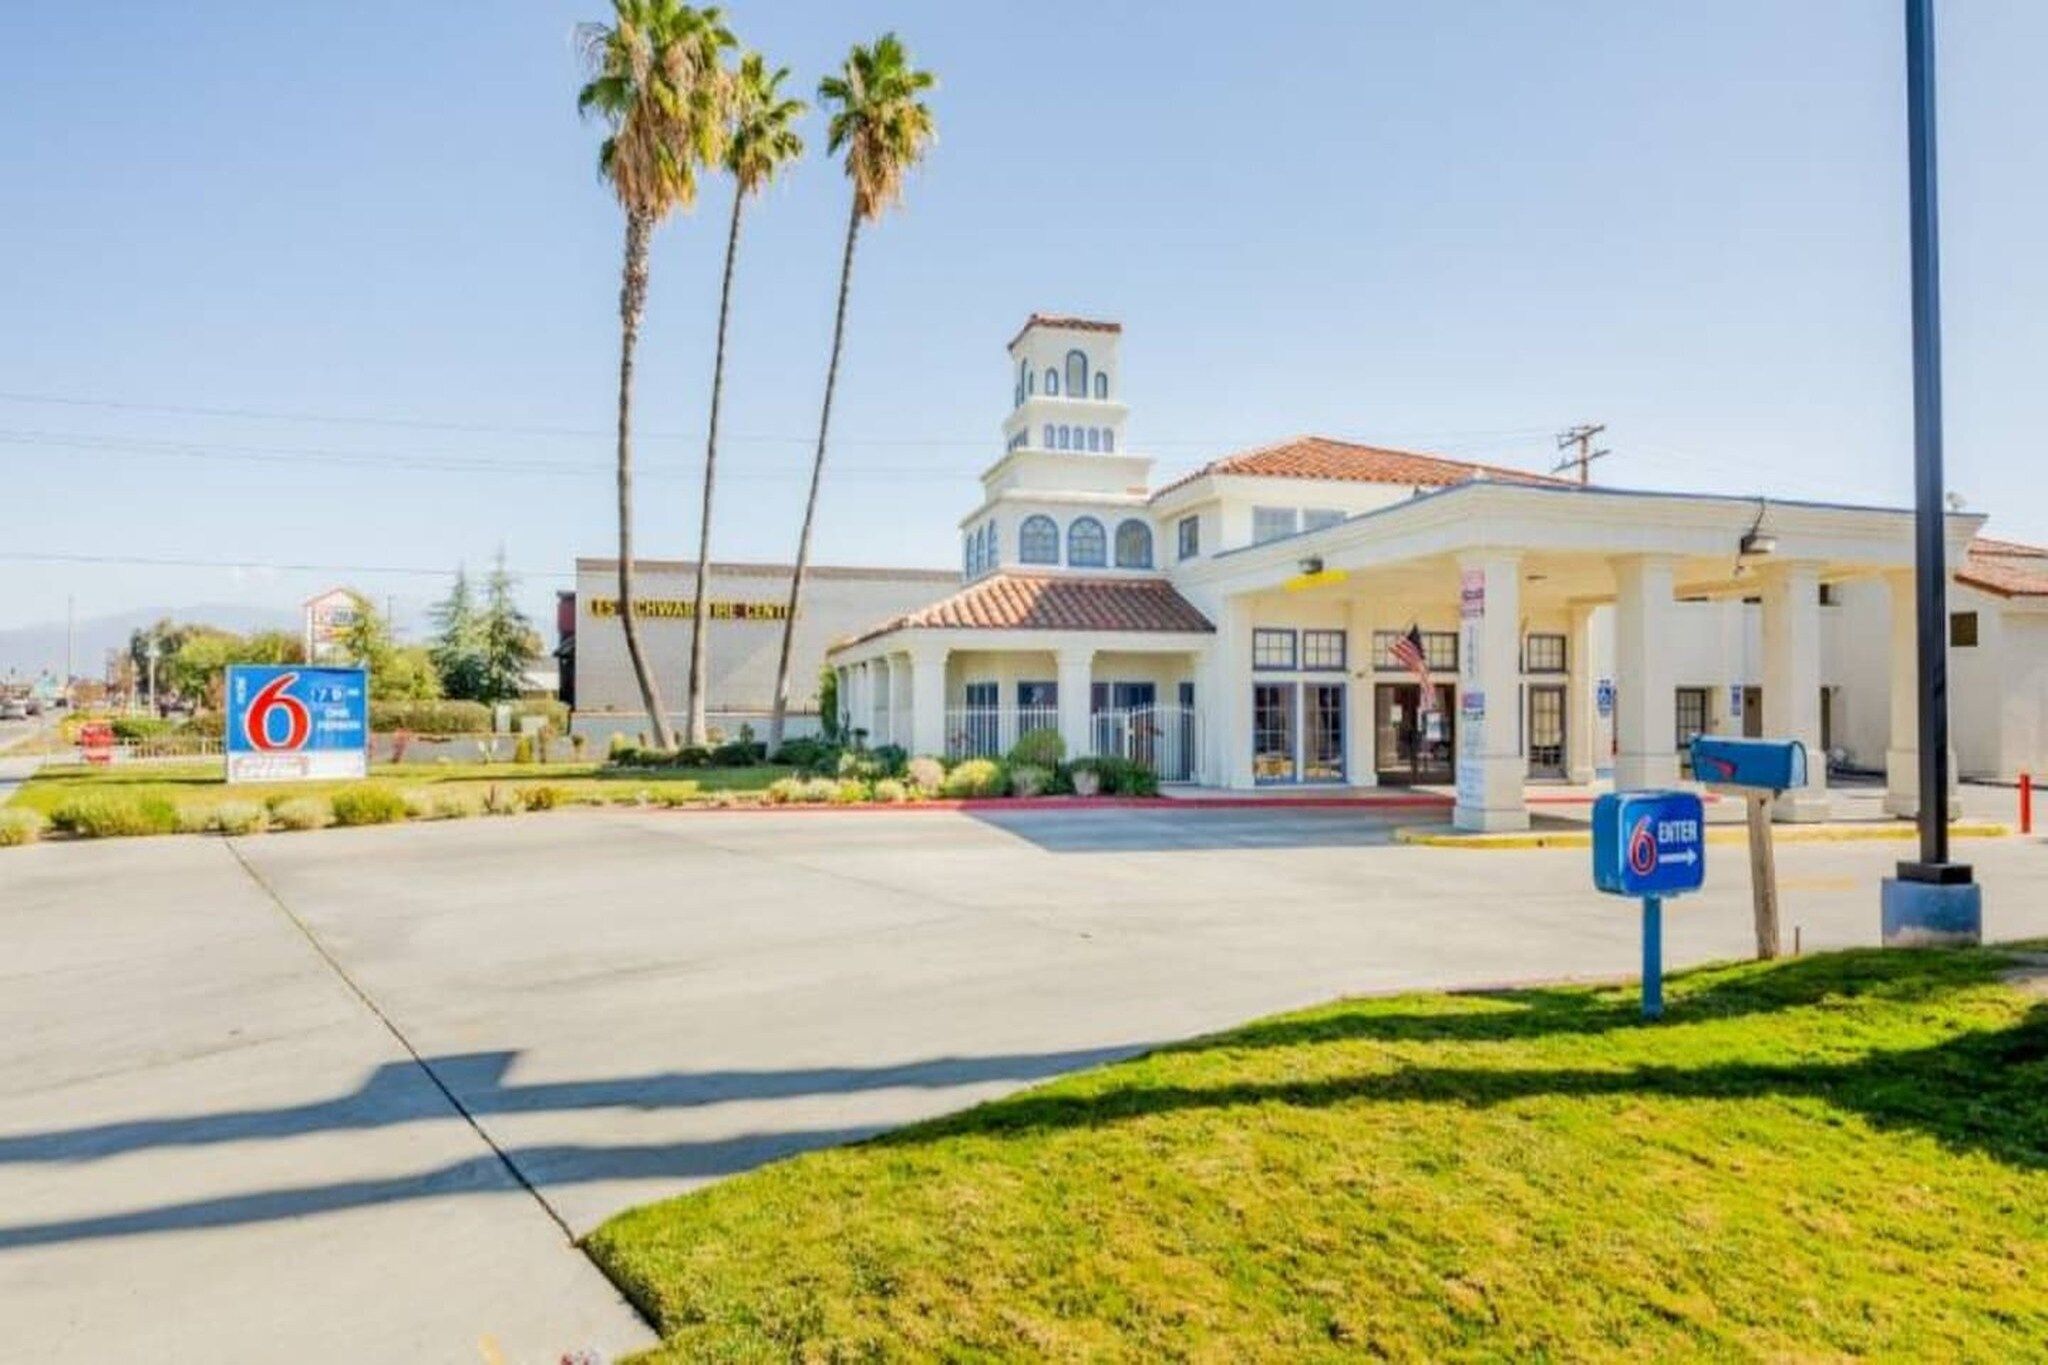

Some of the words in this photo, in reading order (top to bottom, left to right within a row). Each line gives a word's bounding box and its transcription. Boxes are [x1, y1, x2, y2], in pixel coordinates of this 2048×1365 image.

[619, 601, 696, 619] CHWAB
[244, 673, 311, 753] 6
[1628, 815, 1656, 876] 6
[1658, 820, 1697, 843] ENTER
